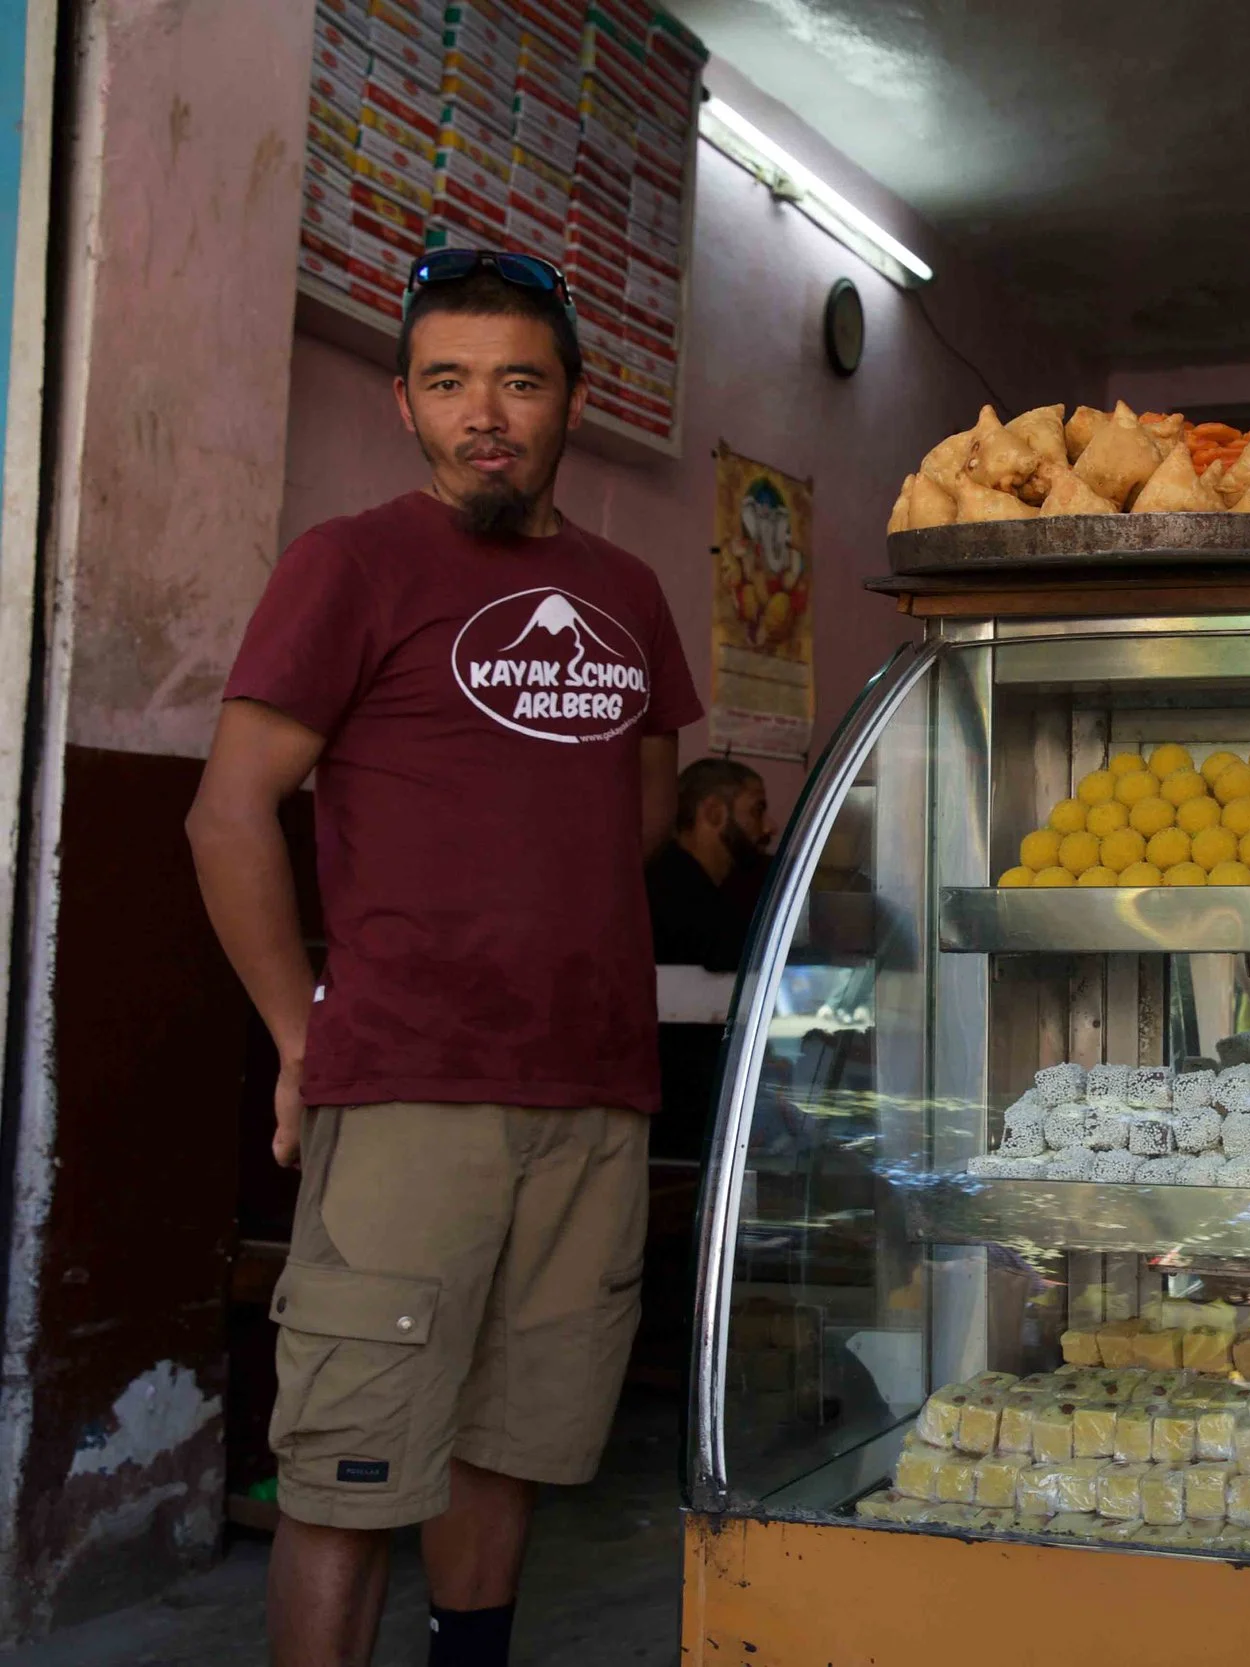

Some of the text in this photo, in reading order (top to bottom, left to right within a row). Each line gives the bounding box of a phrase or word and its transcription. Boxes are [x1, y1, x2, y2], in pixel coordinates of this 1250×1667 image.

[470, 660, 646, 693] KAYAK SCHOOL
[513, 692, 623, 720] ARLBERG
